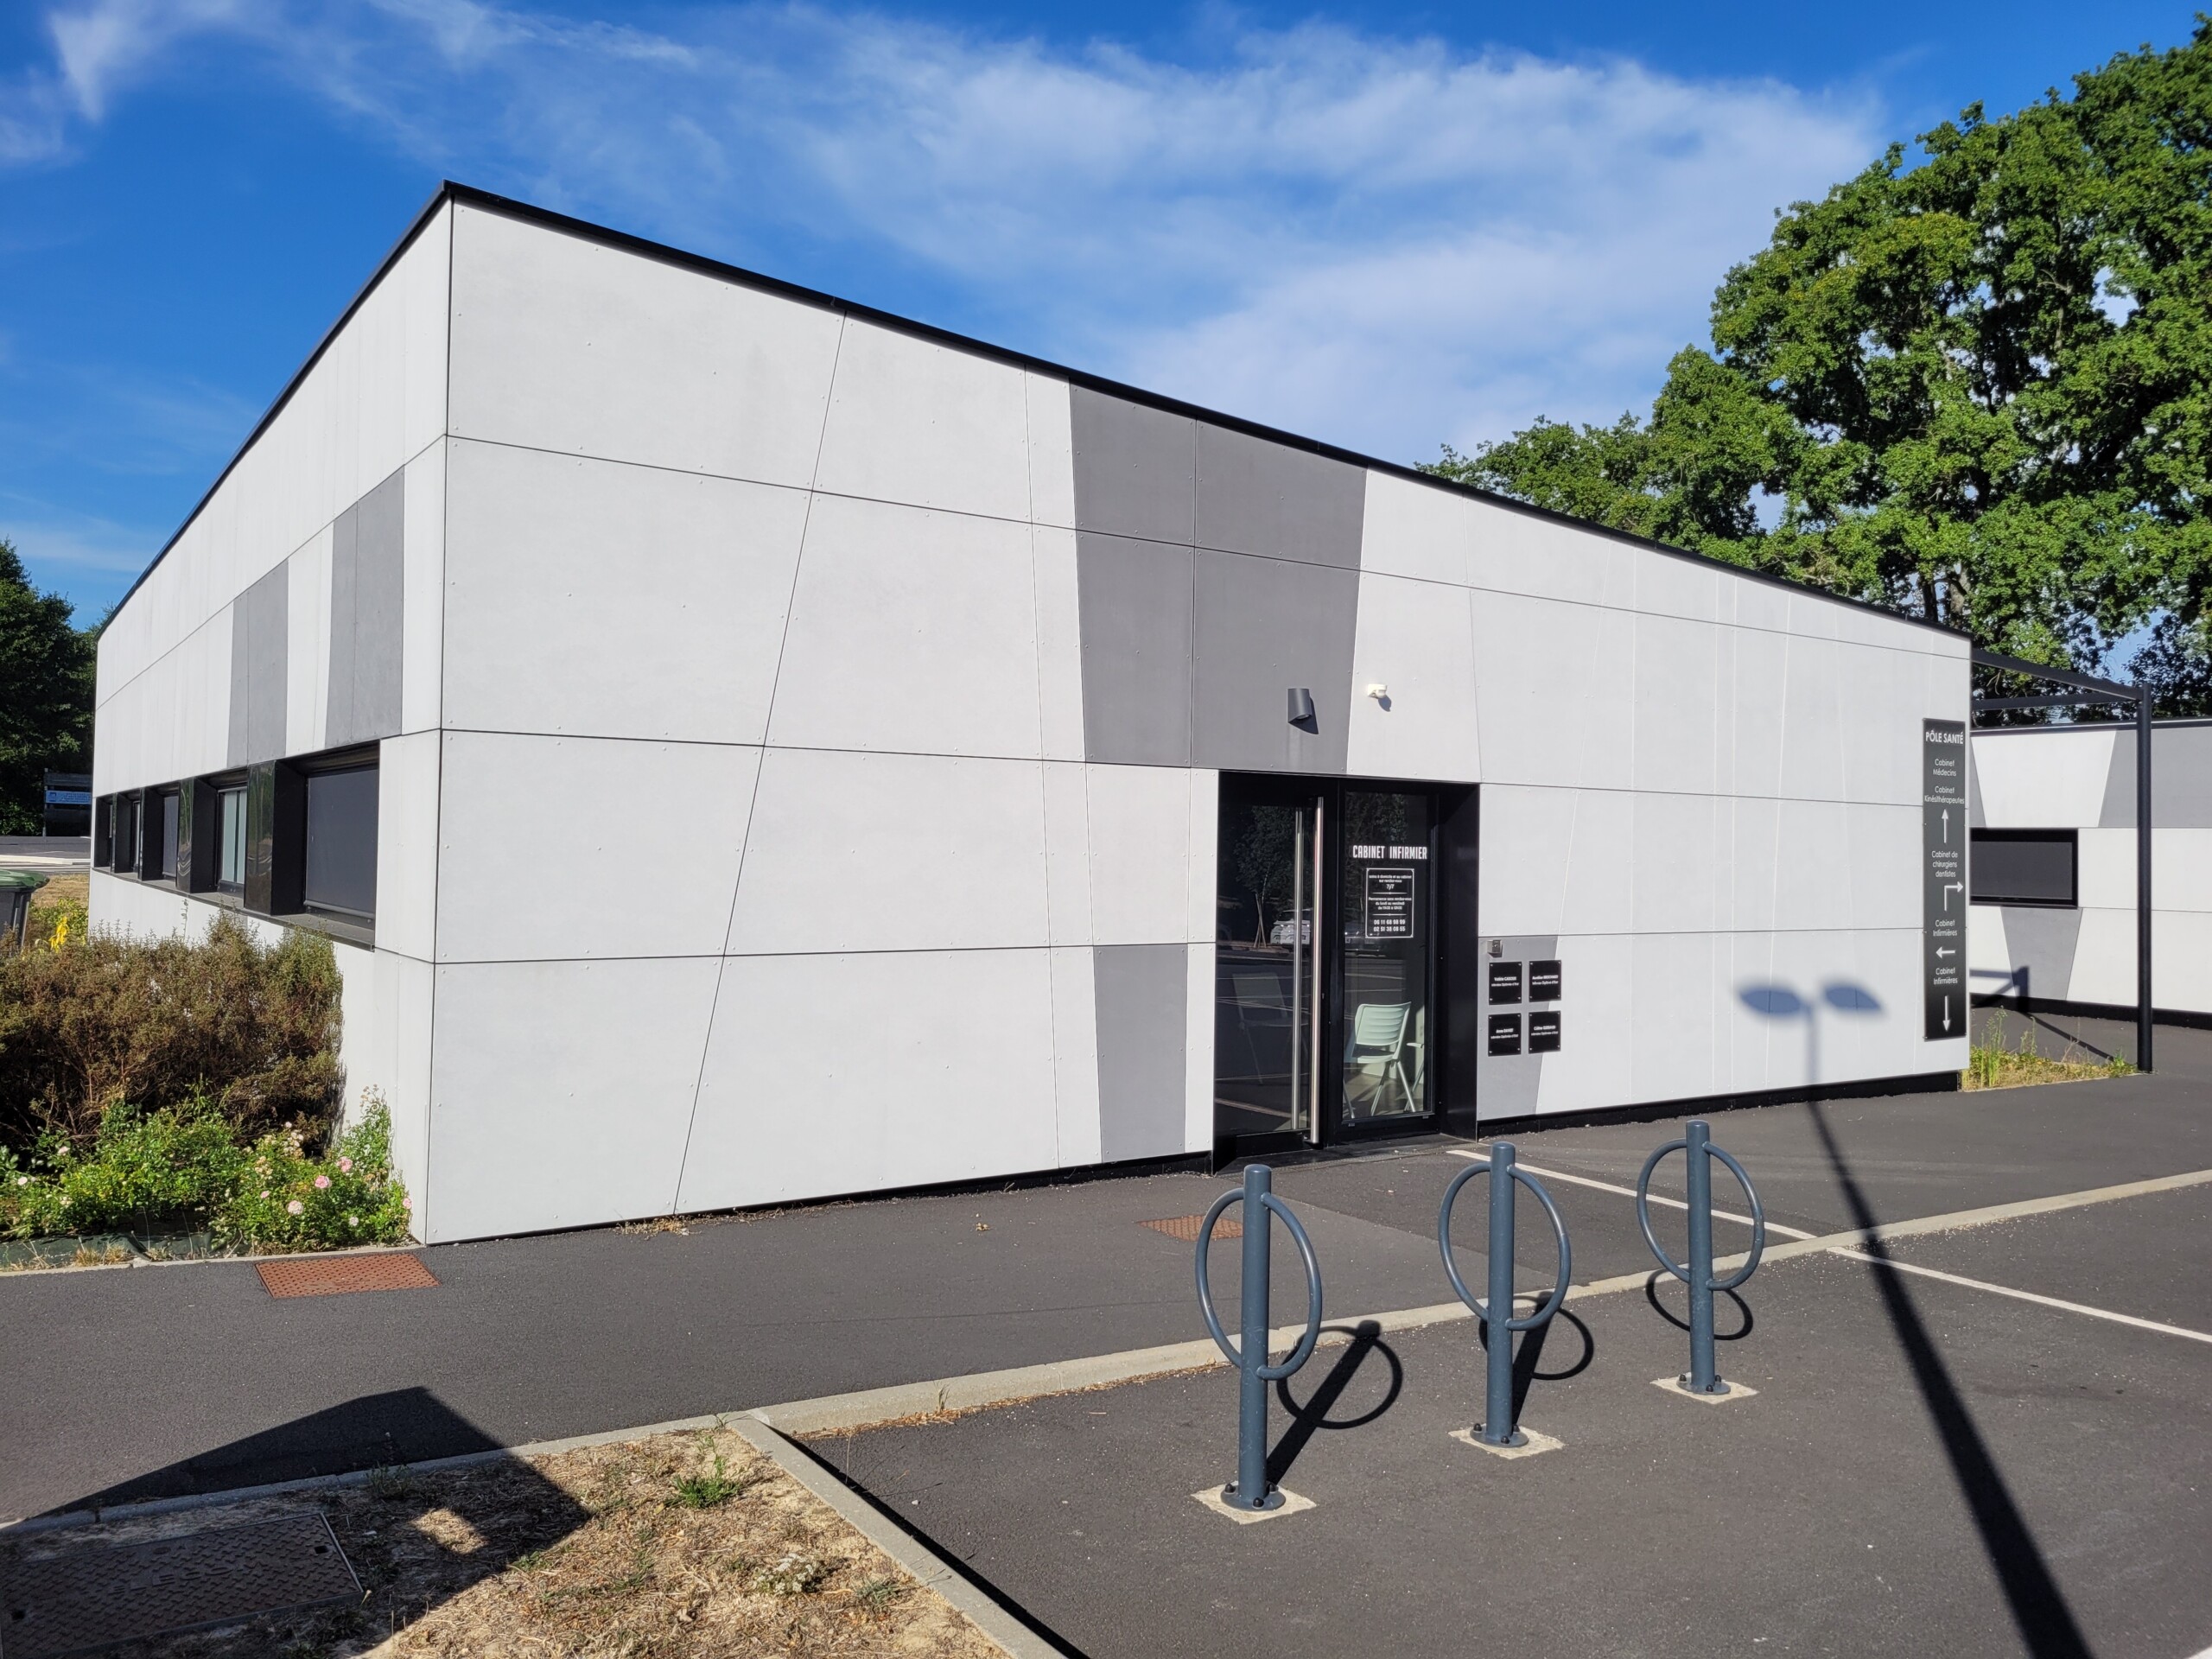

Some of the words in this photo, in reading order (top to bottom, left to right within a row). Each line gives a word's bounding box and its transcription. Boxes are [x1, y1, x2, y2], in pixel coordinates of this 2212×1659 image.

[1926, 730, 1942, 742] PÔLE
[1943, 733, 1964, 745] SANTÉ
[1935, 759, 1955, 767] Cabinet
[1933, 768, 1957, 777] Médecins
[1935, 785, 1955, 794] Cabinet
[1924, 795, 1965, 804] Kinésithérapeutes
[1352, 845, 1385, 859] CABINET
[1389, 846, 1427, 860] INFIRMIER
[1932, 861, 1958, 869] chirurgiens
[1935, 919, 1955, 928] Cabinet
[1936, 967, 1955, 976] Cabinet
